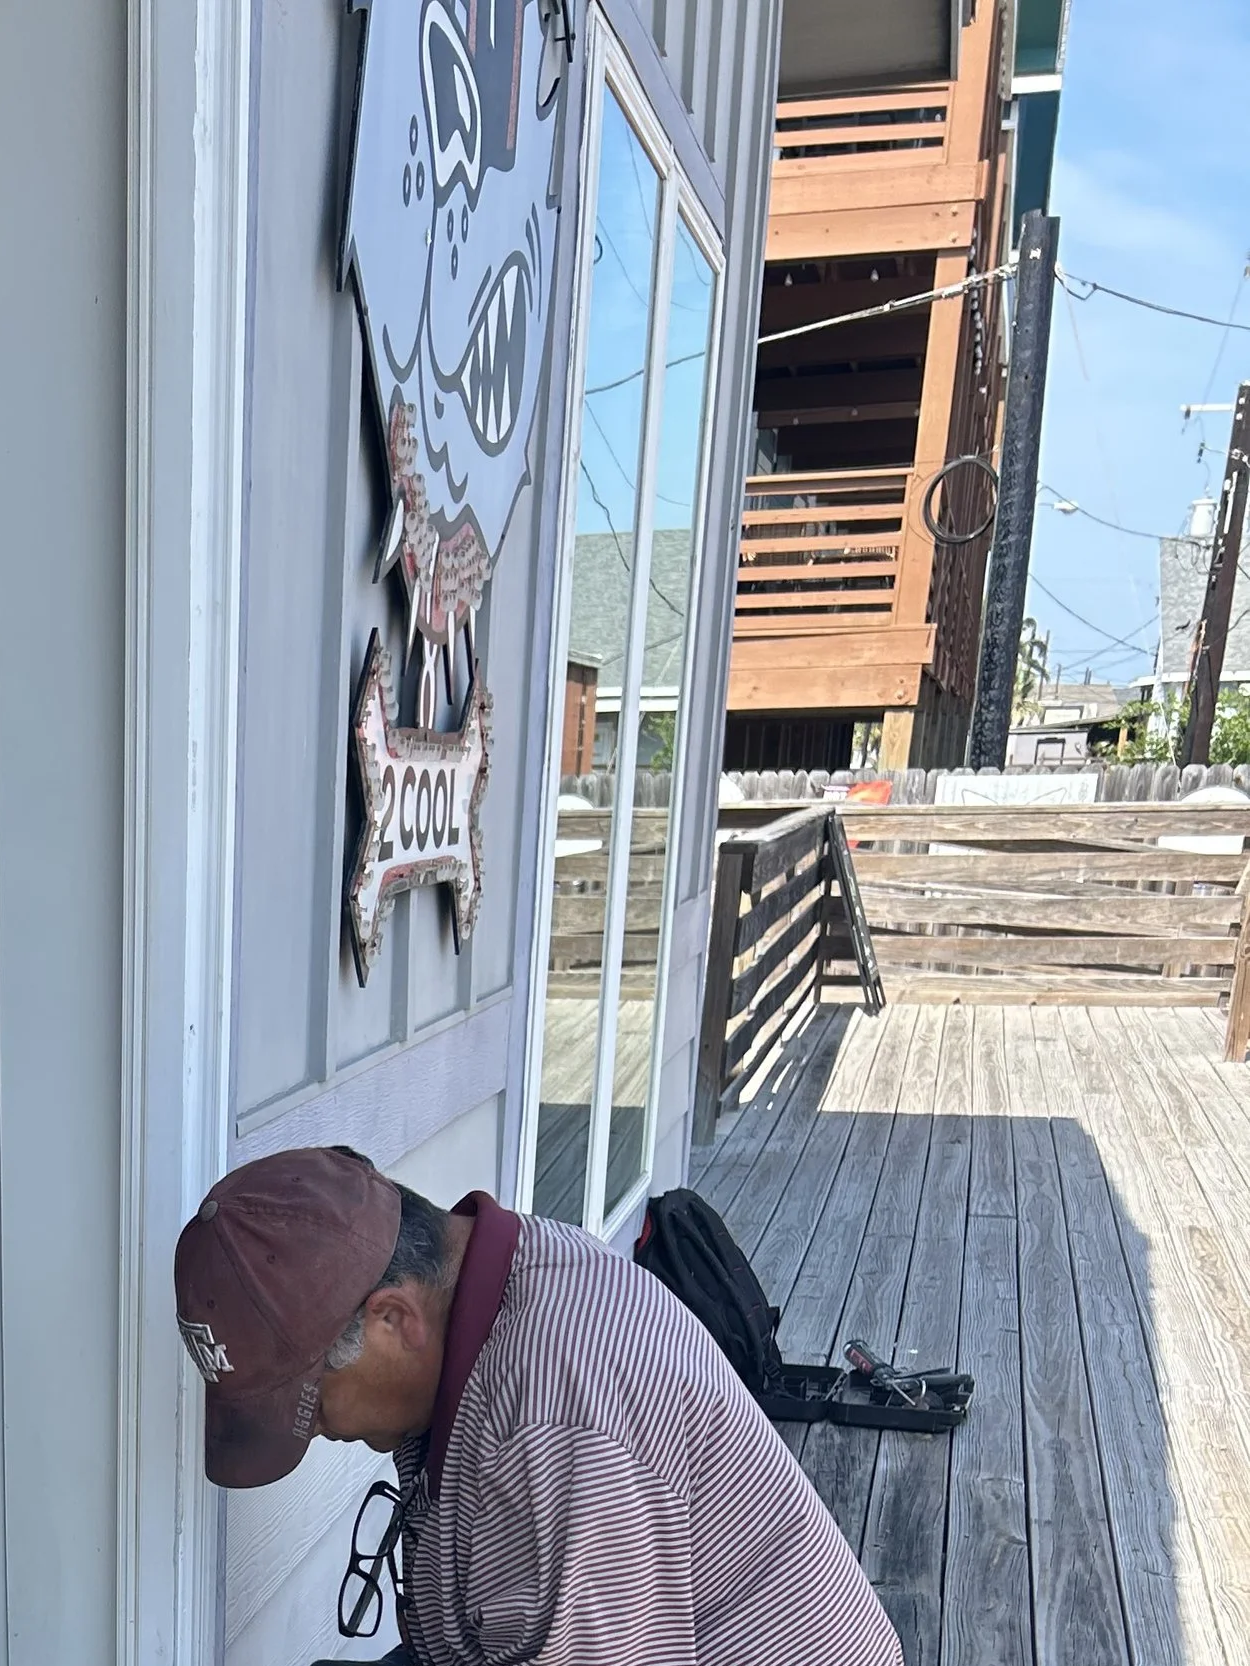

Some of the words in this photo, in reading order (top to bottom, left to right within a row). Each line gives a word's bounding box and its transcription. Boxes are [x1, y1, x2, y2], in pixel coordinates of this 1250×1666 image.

[378, 765, 395, 862] 2
[400, 766, 459, 852] COOL
[292, 1383, 319, 1440] AGGIES
